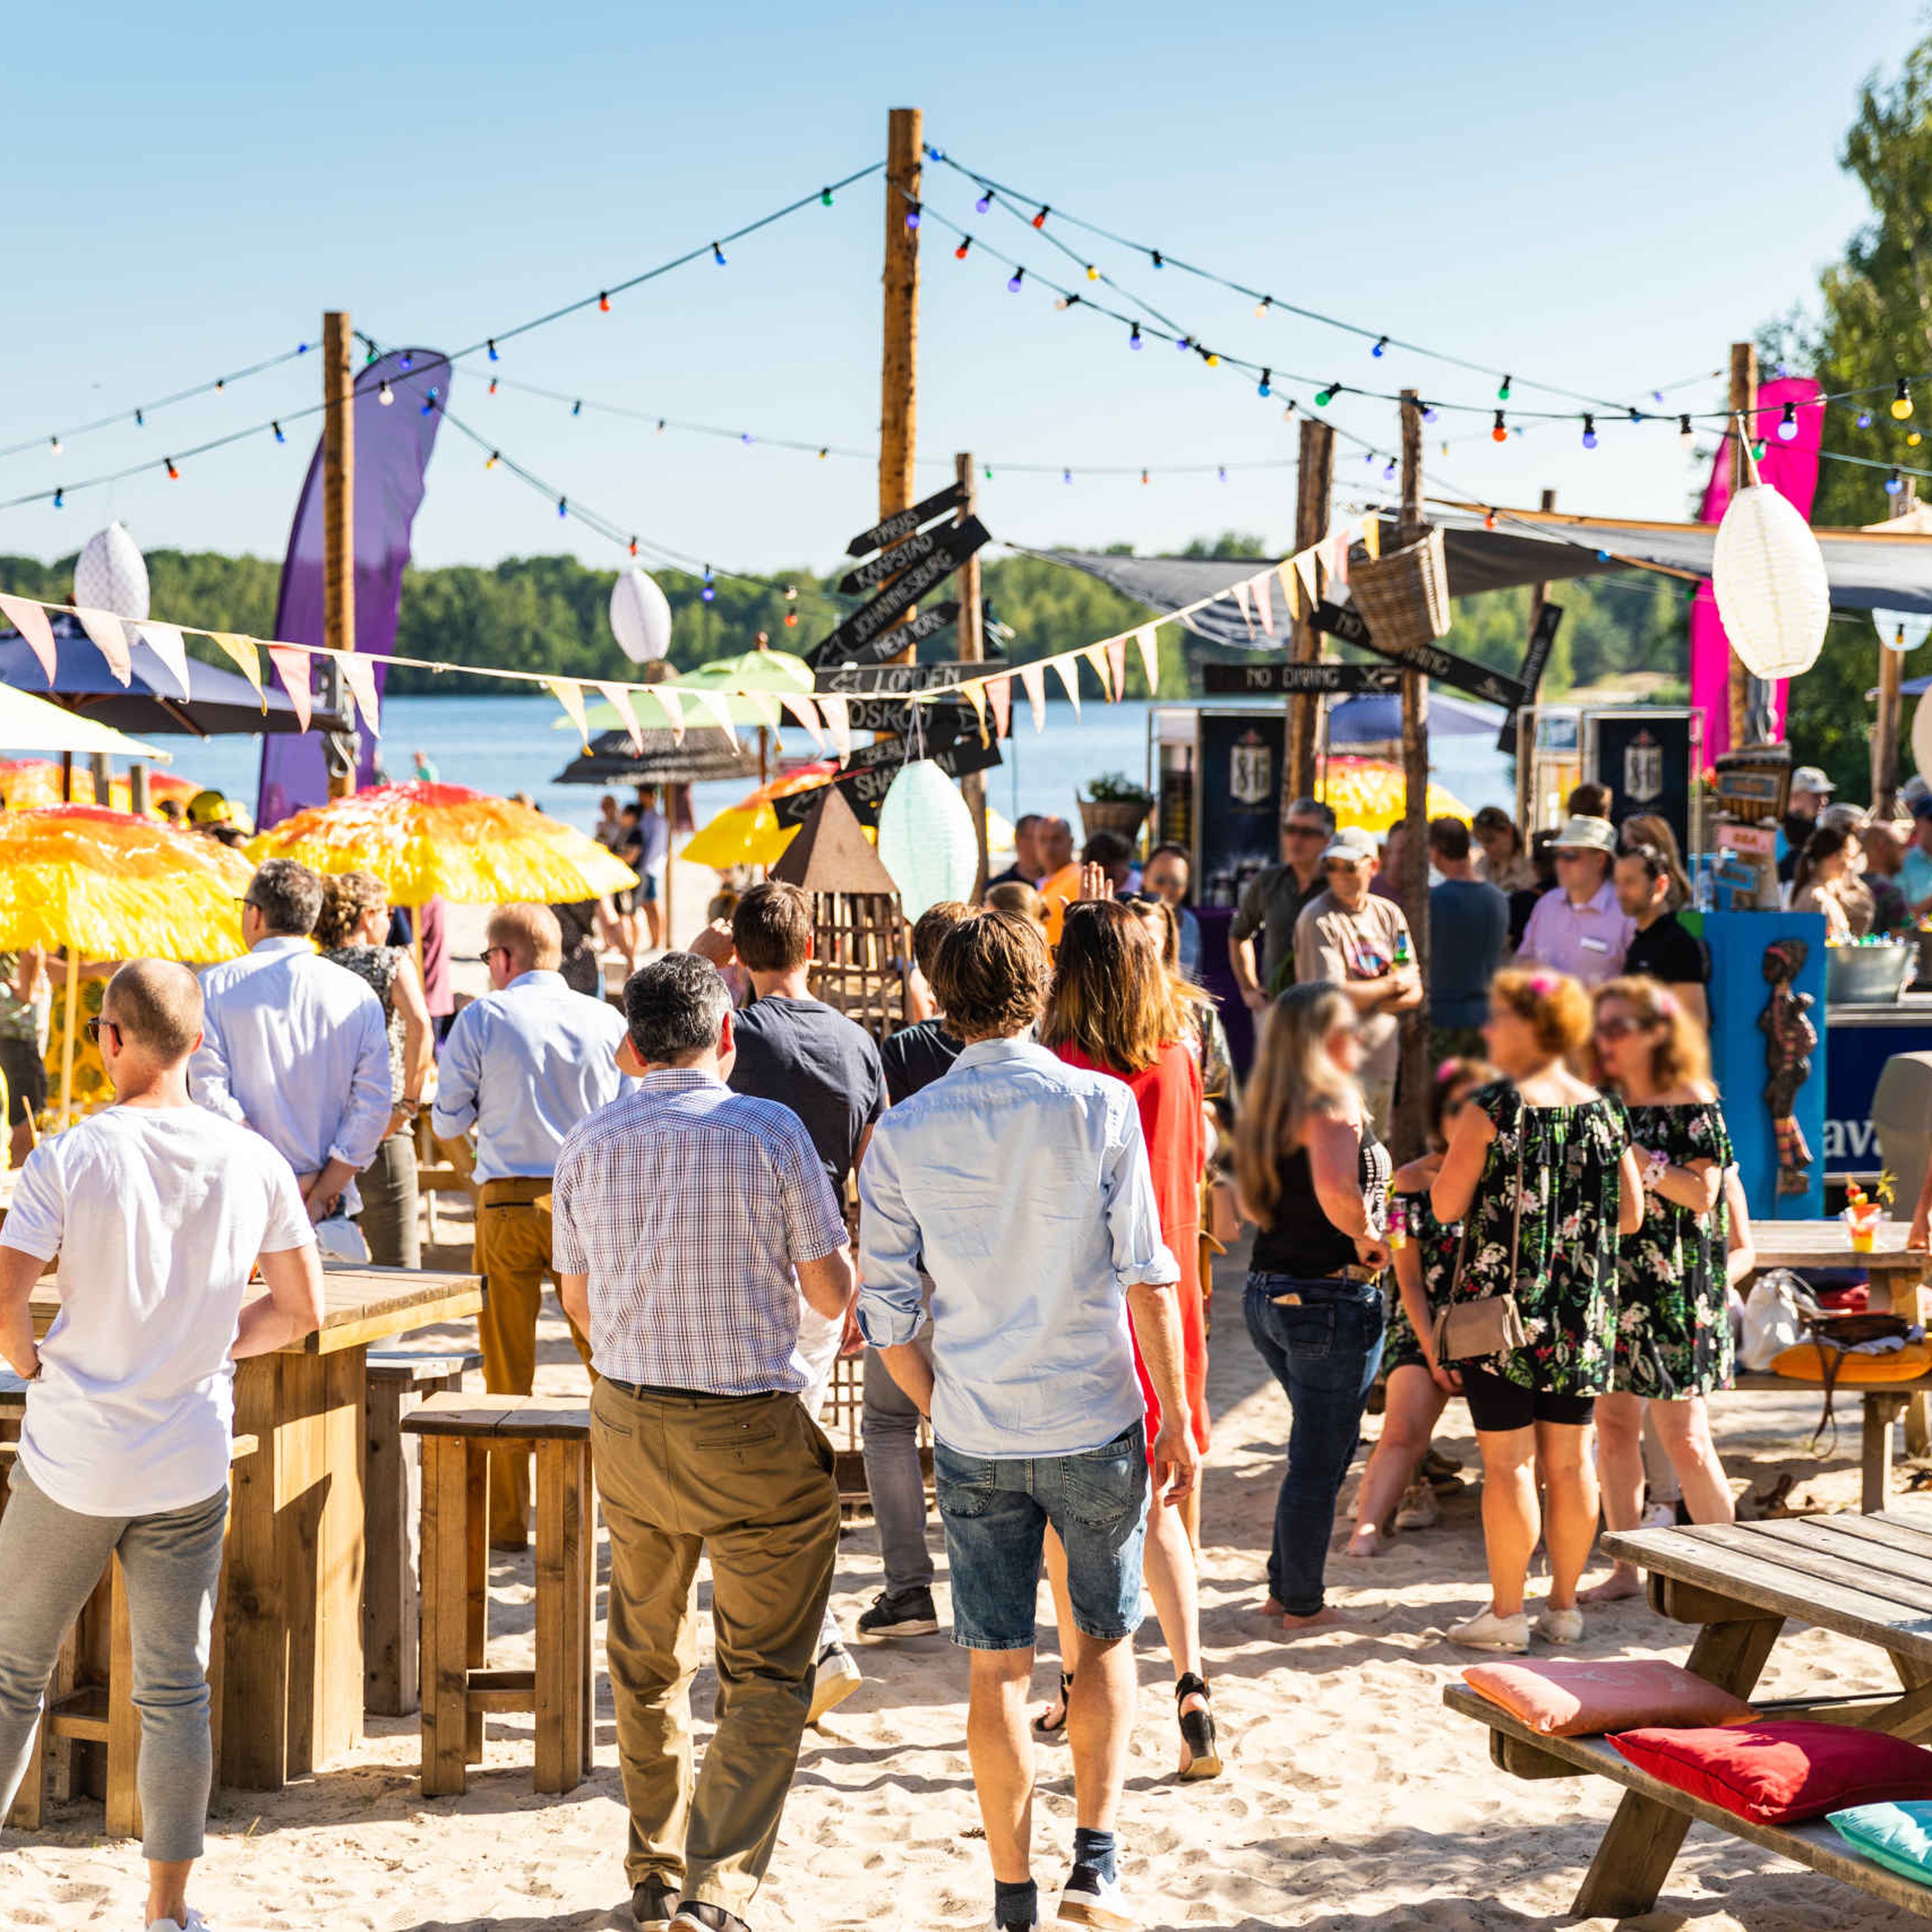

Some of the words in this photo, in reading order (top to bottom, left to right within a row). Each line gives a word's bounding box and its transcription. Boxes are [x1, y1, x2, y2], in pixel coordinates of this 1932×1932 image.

[872, 627, 909, 661] NEW
[908, 609, 947, 638] YORK
[1246, 668, 1272, 688] NO
[1282, 667, 1340, 688] DIVING
